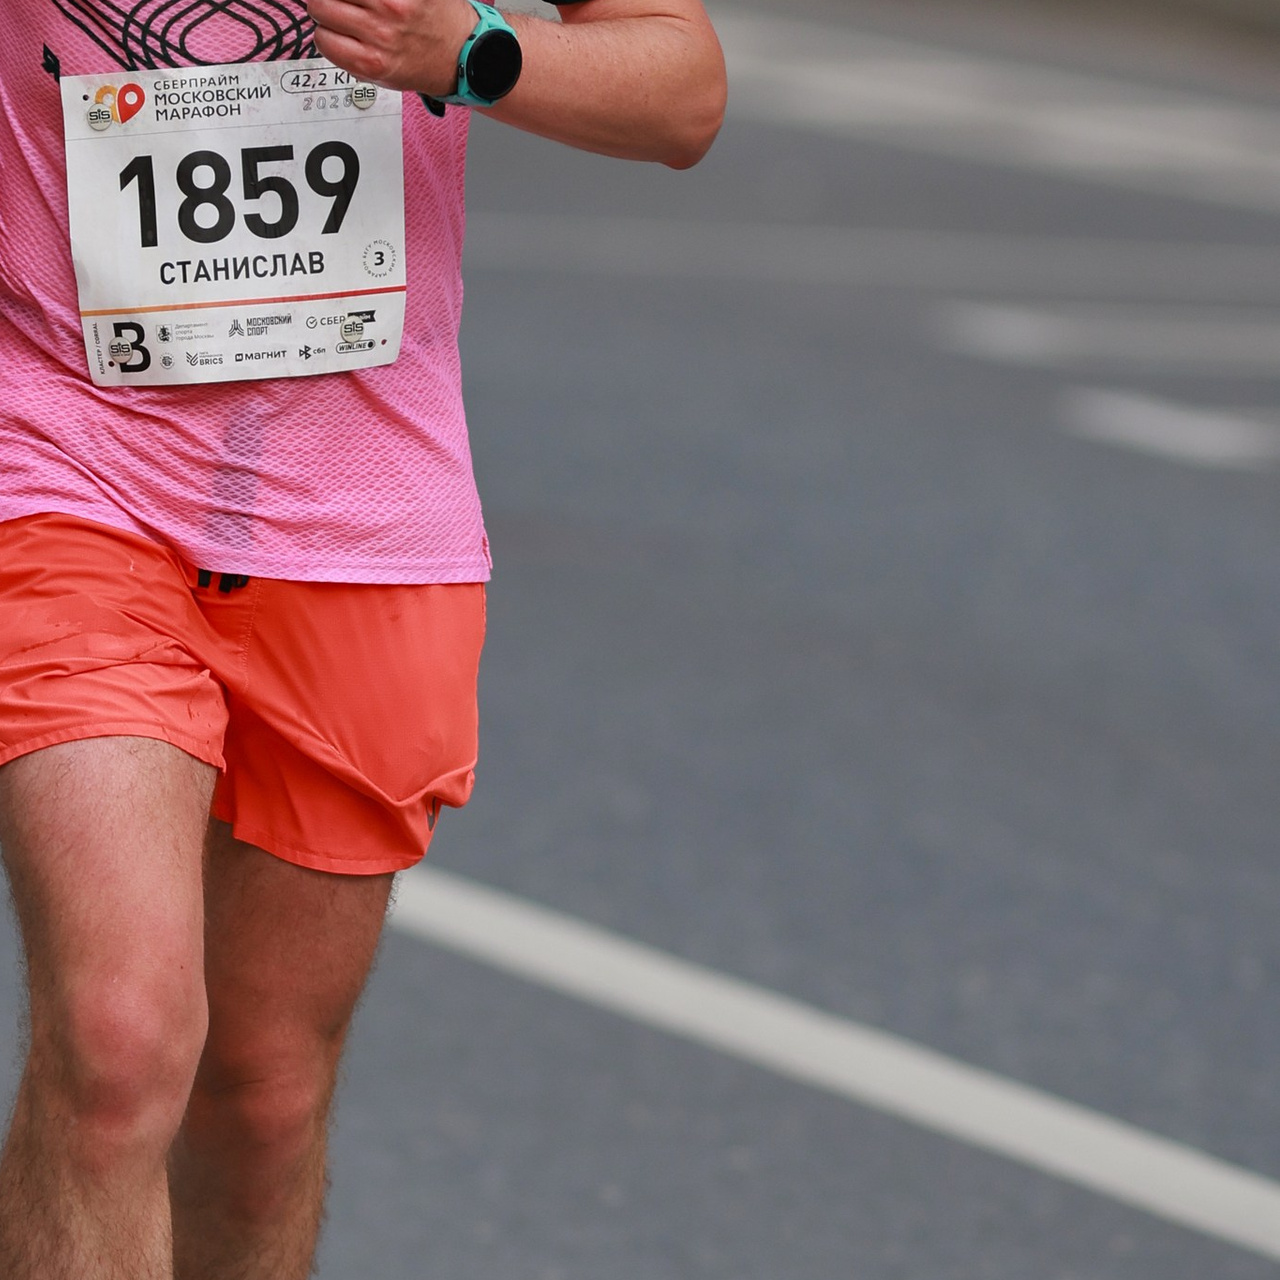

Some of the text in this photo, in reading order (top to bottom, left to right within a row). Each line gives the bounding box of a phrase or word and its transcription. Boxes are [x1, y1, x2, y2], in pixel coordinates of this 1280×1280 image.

[153, 75, 239, 91] СБЕРПРАЙМ
[290, 73, 327, 89] 42,2
[154, 84, 272, 106] МОСКОВСКИЙ
[155, 103, 241, 121] МАРАФОН
[119, 140, 361, 248] 1859
[374, 251, 385, 266] 3
[159, 251, 325, 285] СТАНИСЛАВ
[246, 313, 292, 327] МОСКОВСКИЙ
[247, 326, 268, 336] СПОРТ
[113, 322, 151, 373] B
[96, 349, 106, 375] КЛАСТЕР
[199, 357, 224, 366] BRICS
